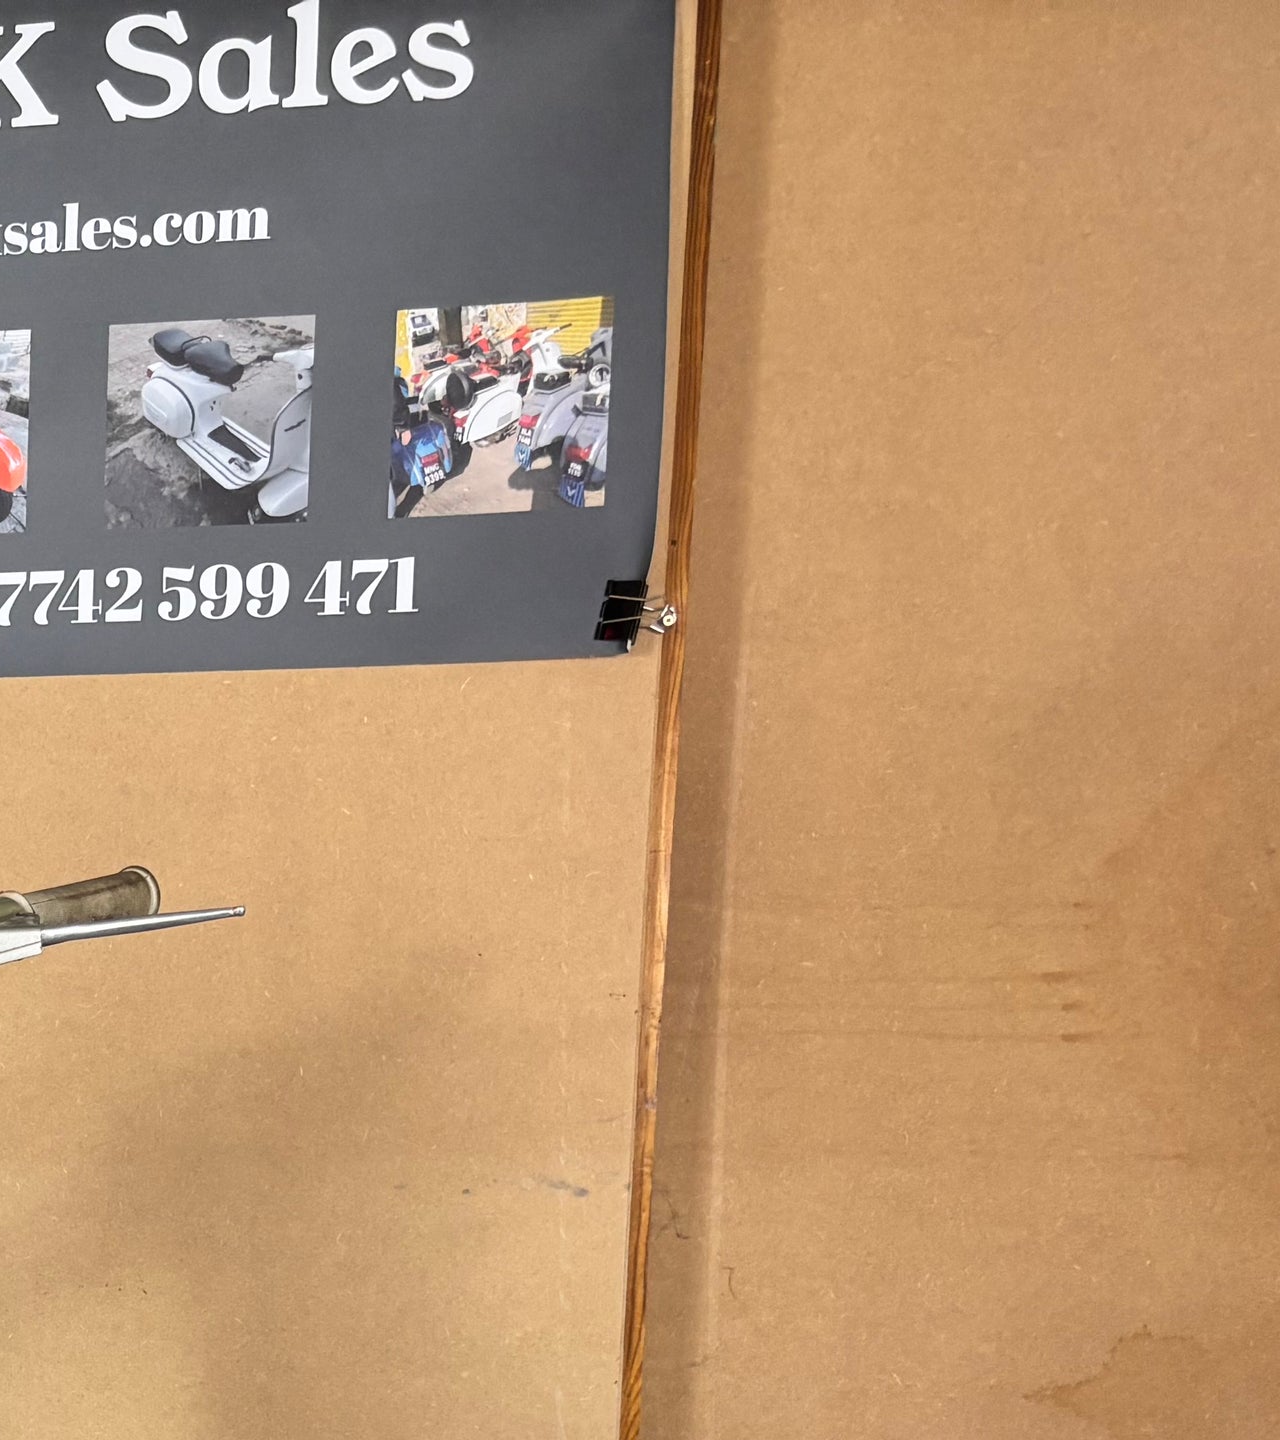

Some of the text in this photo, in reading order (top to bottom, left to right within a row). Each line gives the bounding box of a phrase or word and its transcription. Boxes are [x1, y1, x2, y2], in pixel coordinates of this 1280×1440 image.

[95, 0, 476, 122] Sales
[157, 561, 290, 622] 599
[303, 556, 419, 616] 471
